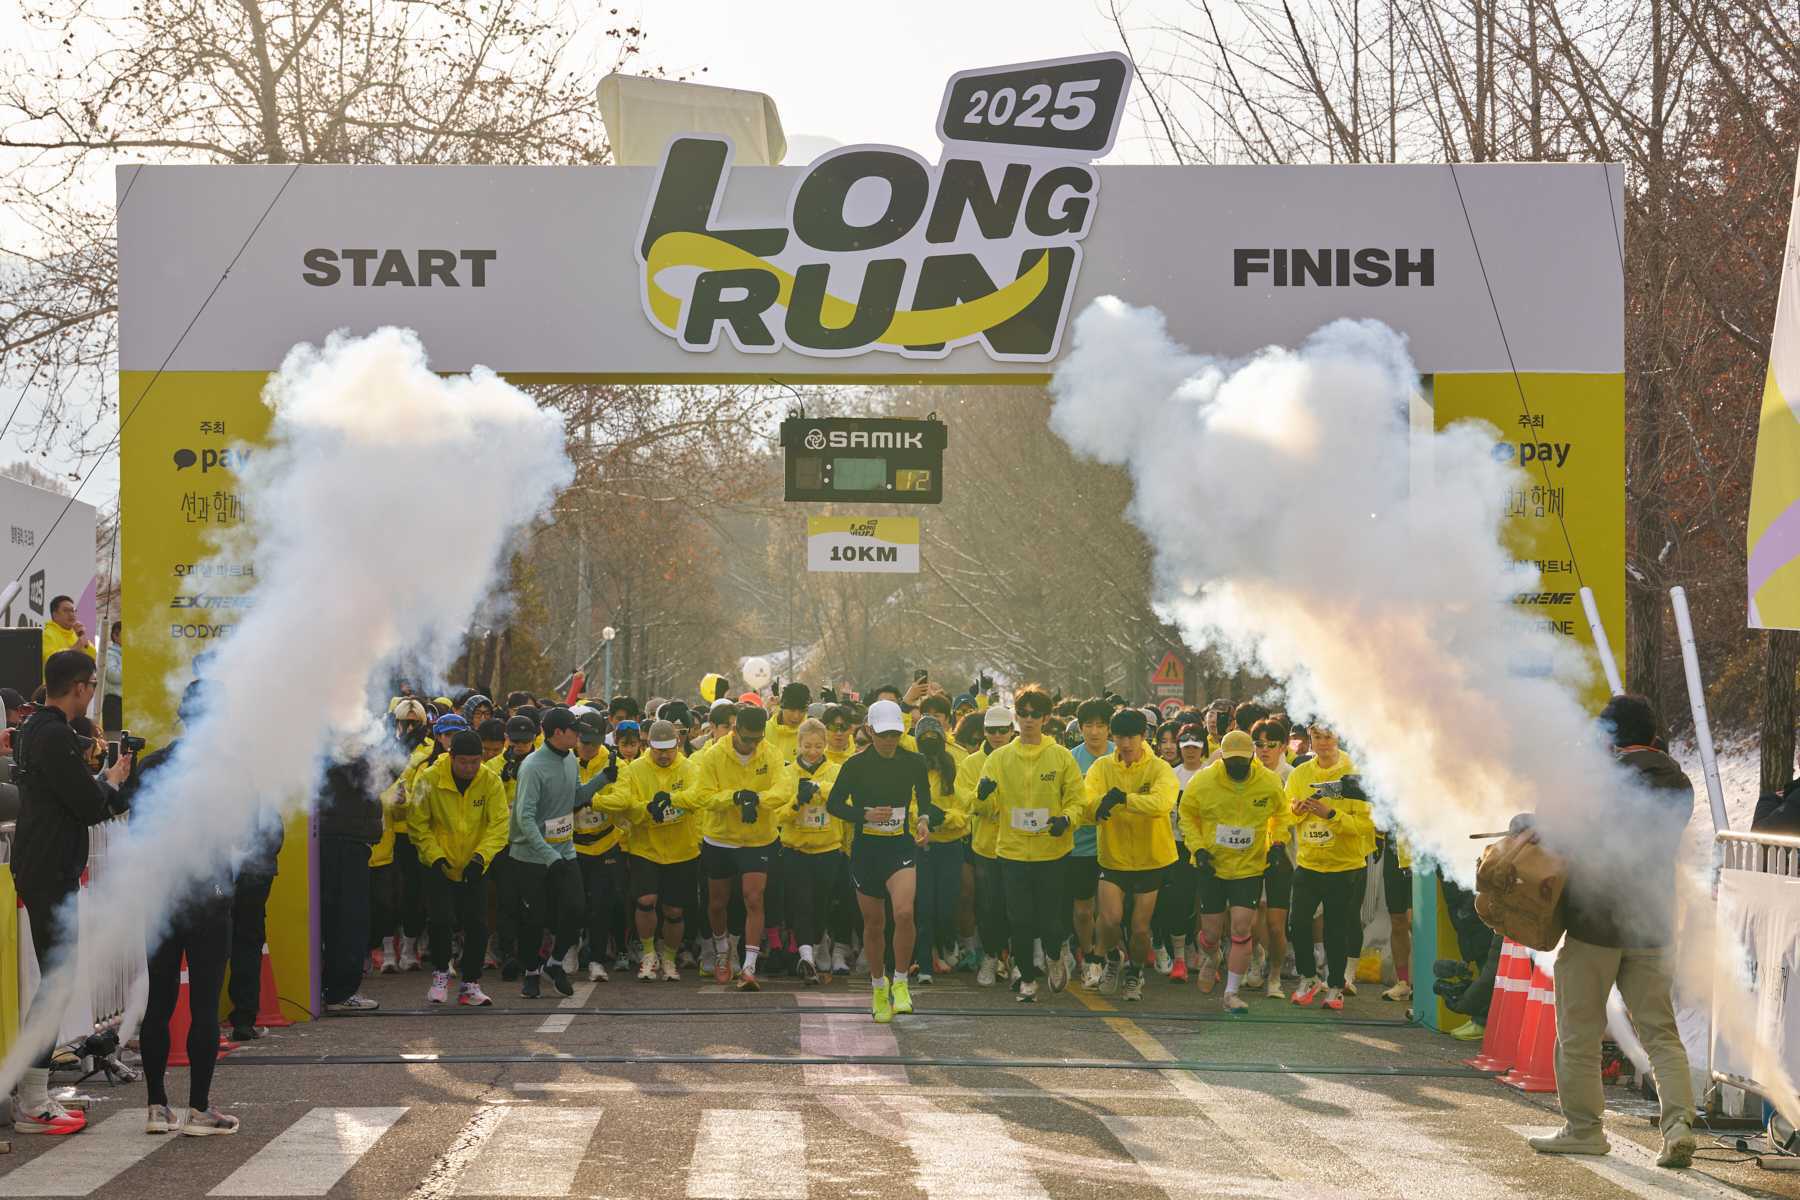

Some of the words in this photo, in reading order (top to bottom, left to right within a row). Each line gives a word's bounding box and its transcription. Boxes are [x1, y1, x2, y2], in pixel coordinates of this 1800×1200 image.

[963, 79, 1101, 131] 2025
[641, 138, 1093, 261] LONG
[302, 248, 497, 287] START
[1234, 248, 1435, 287] FINISH
[684, 246, 1075, 355] RUN
[200, 421, 225, 435] 주최
[1518, 415, 1545, 429] 주최
[829, 431, 924, 449] SAMIK
[202, 448, 253, 473] pay
[1520, 442, 1571, 468] pay
[830, 546, 898, 562] 10KM
